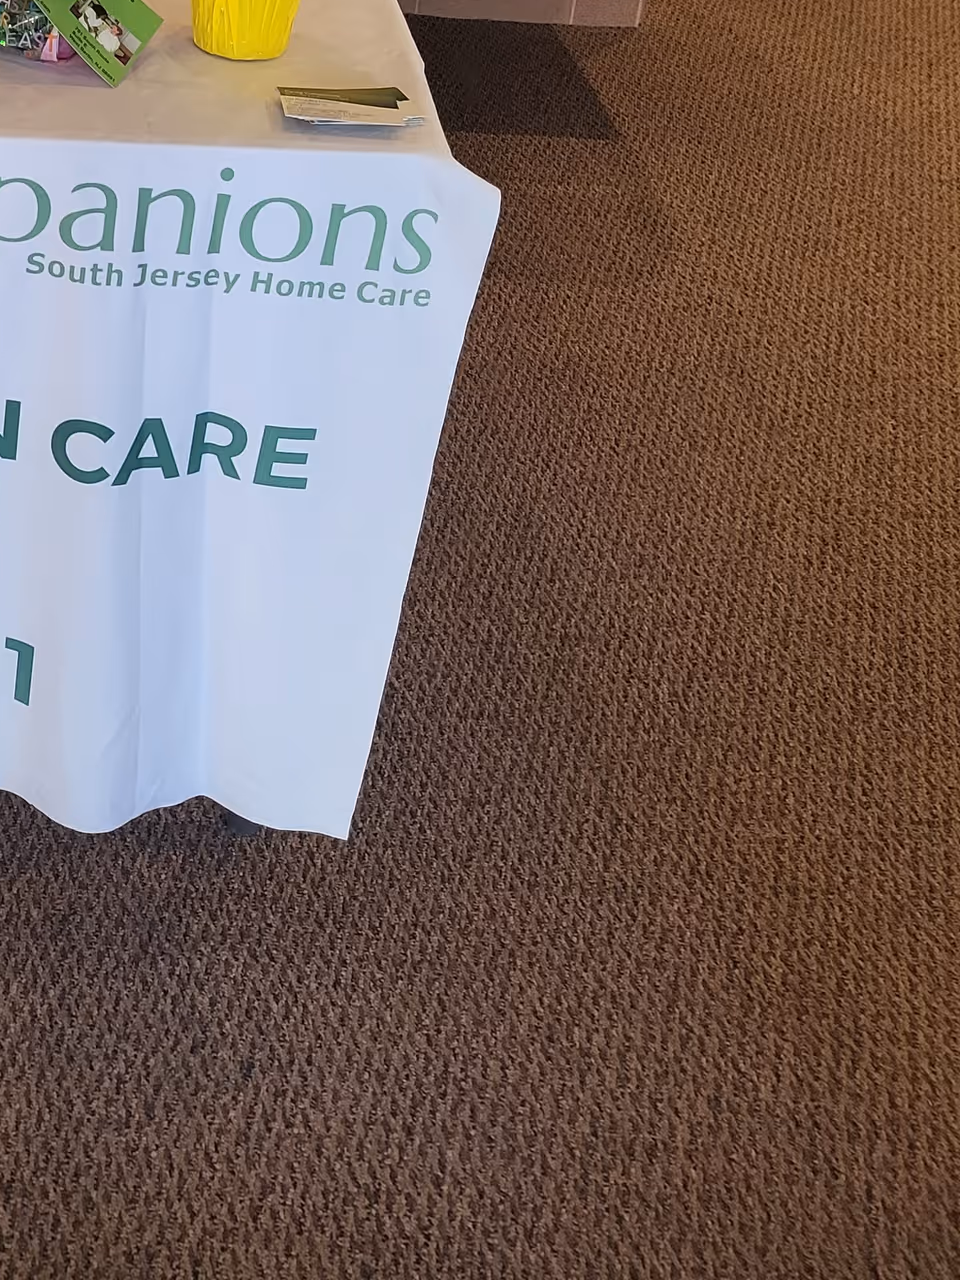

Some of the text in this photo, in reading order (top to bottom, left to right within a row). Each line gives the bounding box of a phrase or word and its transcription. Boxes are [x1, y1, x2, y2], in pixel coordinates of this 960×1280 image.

[25, 251, 431, 307] South Jersey Home Care
[50, 412, 318, 490] CARE
